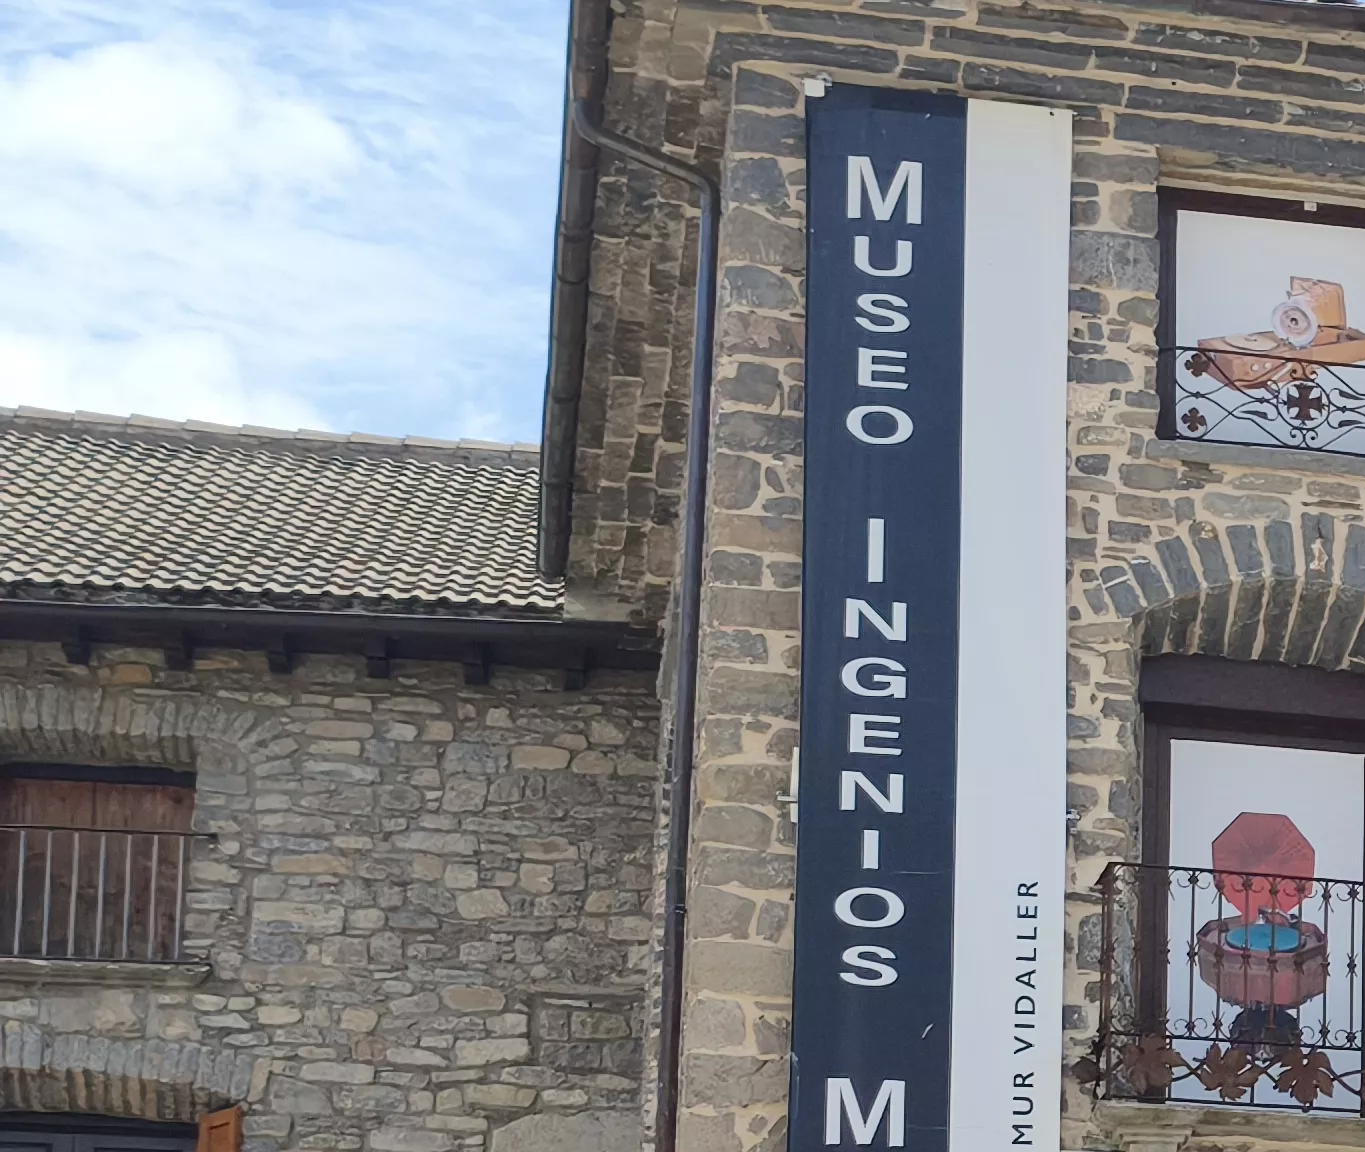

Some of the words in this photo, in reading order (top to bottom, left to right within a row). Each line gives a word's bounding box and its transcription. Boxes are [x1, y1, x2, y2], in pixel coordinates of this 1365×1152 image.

[845, 155, 924, 446] MUSEO
[833, 517, 908, 988] INGENIOS
[1013, 881, 1039, 1055] VIDALLER
[1011, 1071, 1035, 1146] MUR
